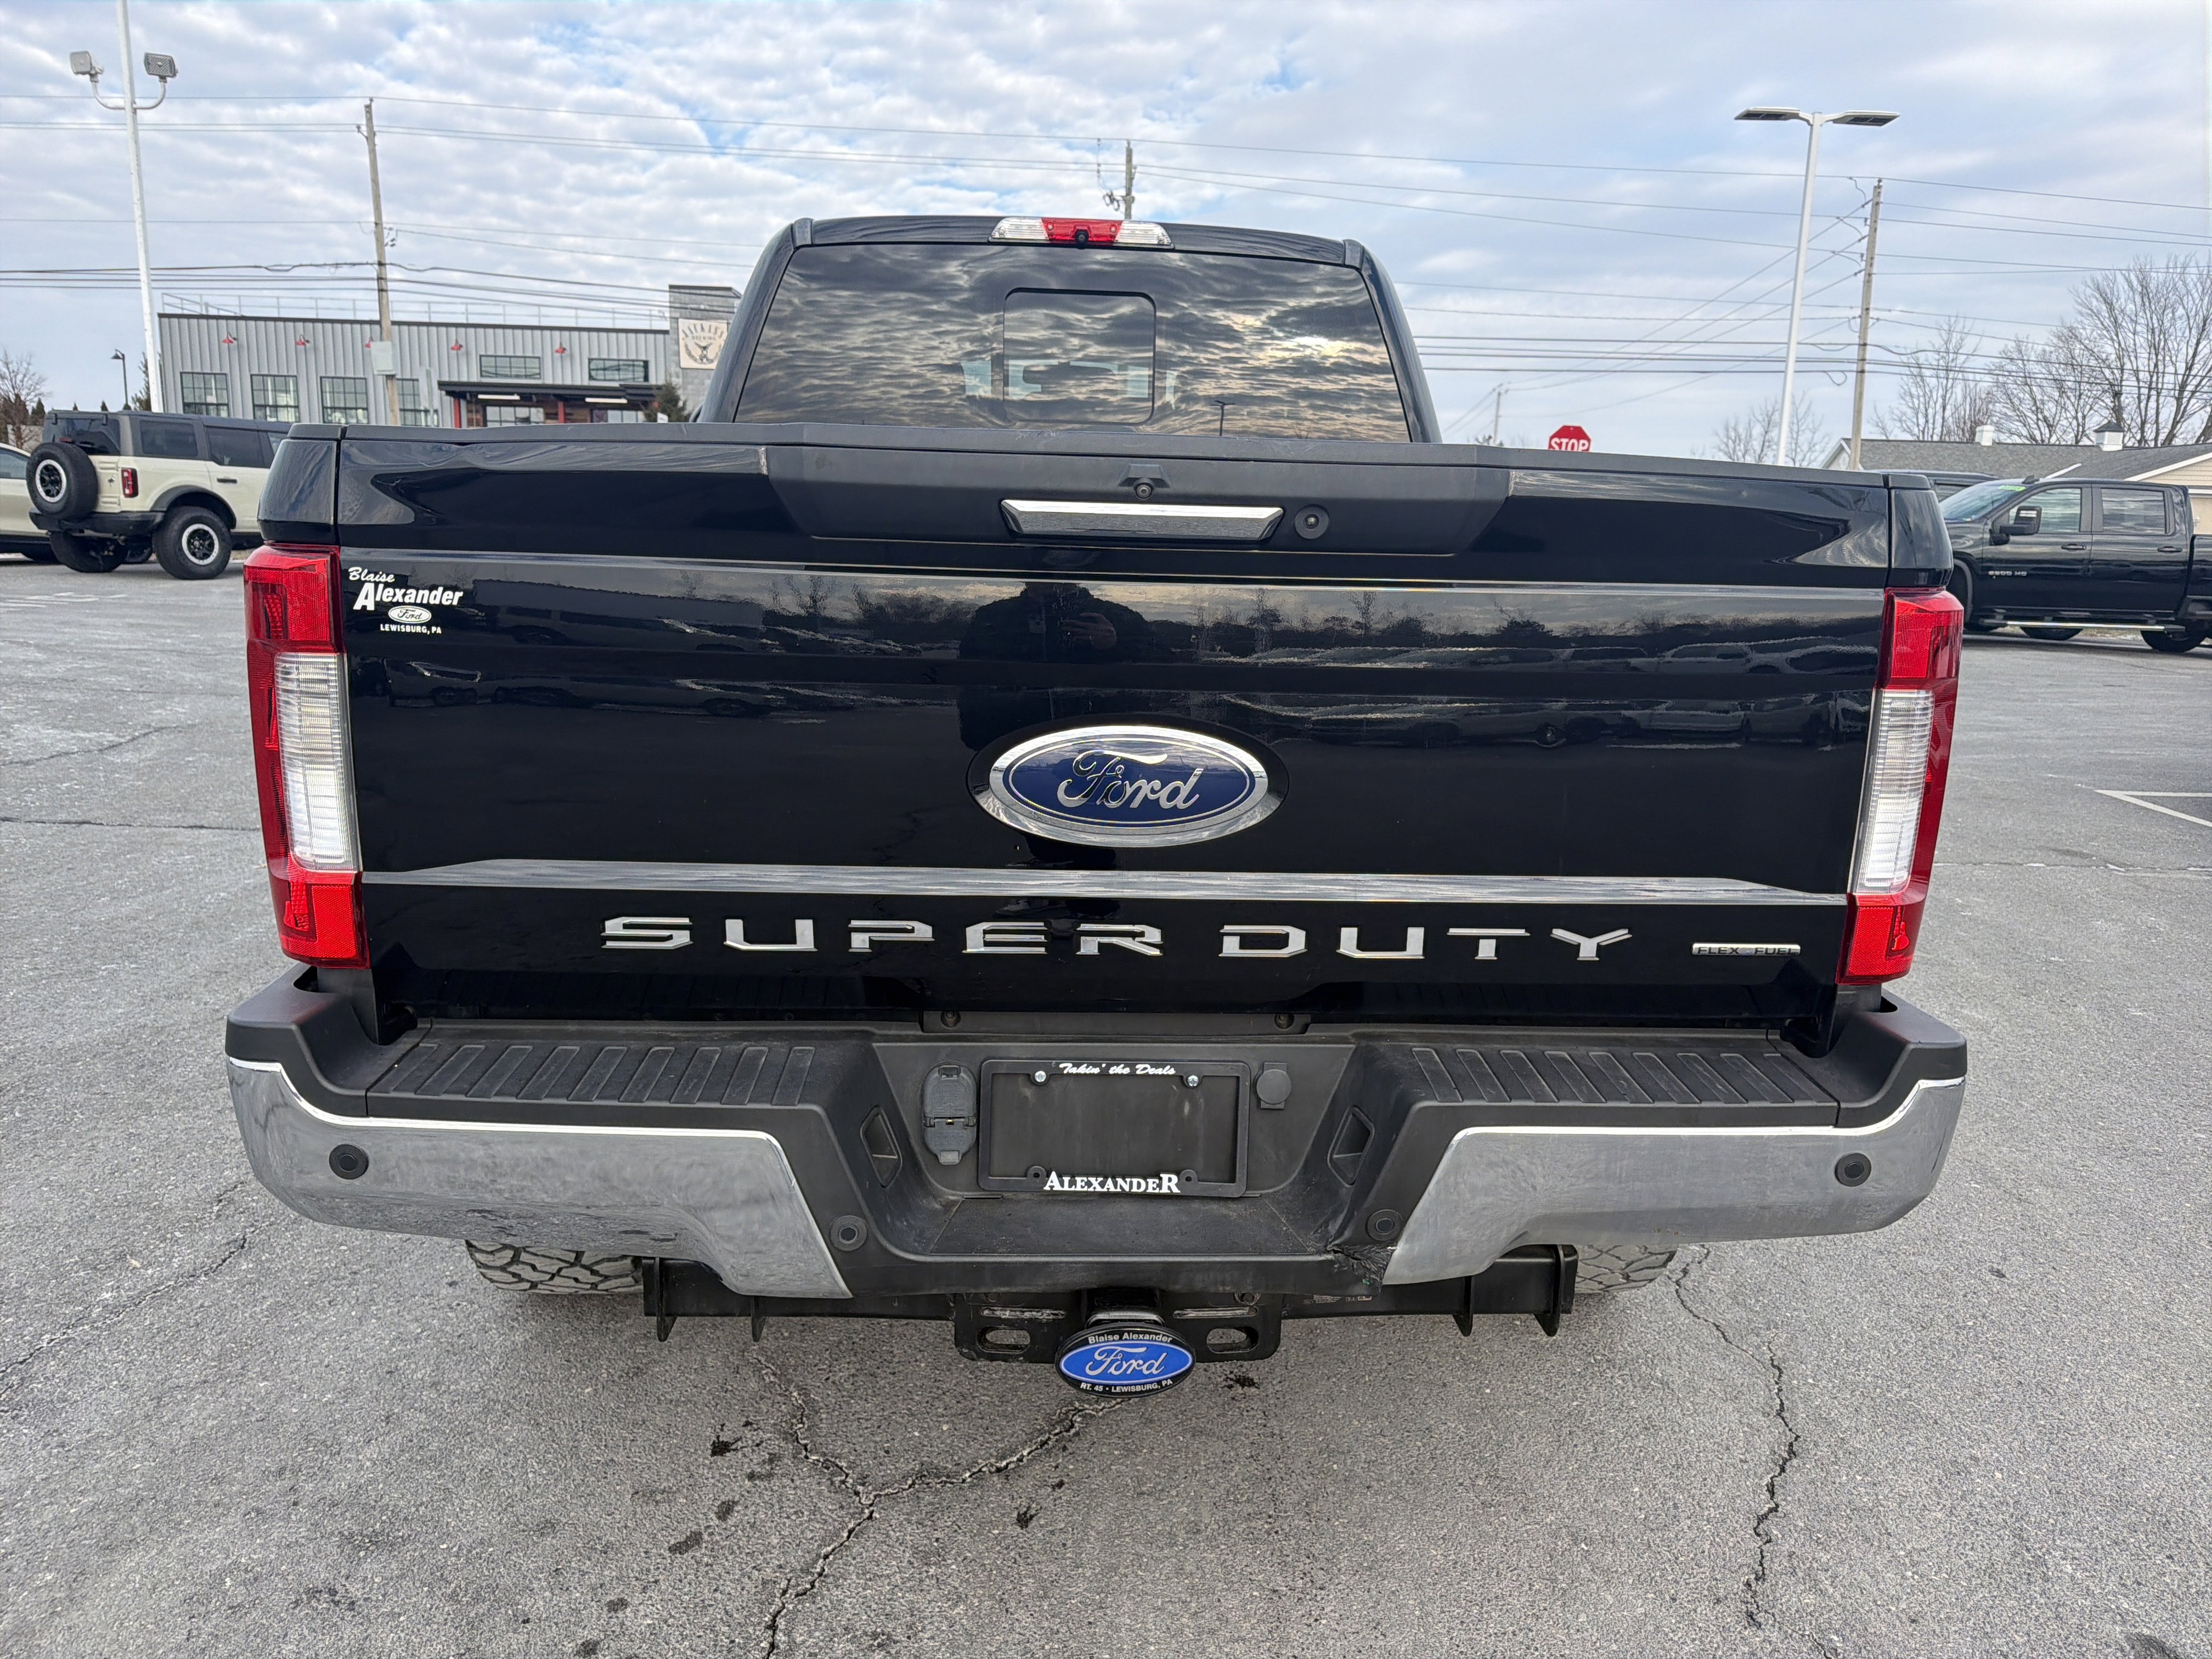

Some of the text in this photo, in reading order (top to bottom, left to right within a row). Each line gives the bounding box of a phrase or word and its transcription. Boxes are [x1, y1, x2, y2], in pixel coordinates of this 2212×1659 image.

[1550, 437, 1589, 452] STOP
[348, 567, 395, 583] Blaise
[353, 583, 464, 611] Alexander
[397, 609, 422, 620] Ford
[380, 624, 430, 635] LEWISBURG,
[1057, 750, 1205, 809] Ford
[600, 916, 1633, 961] SUPER DUTY
[1697, 946, 1799, 956] FLEX FUEL
[1059, 1063, 1176, 1075] Takin' the Deals
[1043, 1171, 1181, 1193] ALEXANDER
[1088, 1332, 1173, 1344] Blaise Alexander
[1085, 1346, 1167, 1376] Ford
[1111, 1382, 1161, 1392] LEWISBURG,
[1162, 1379, 1173, 1387] PA
